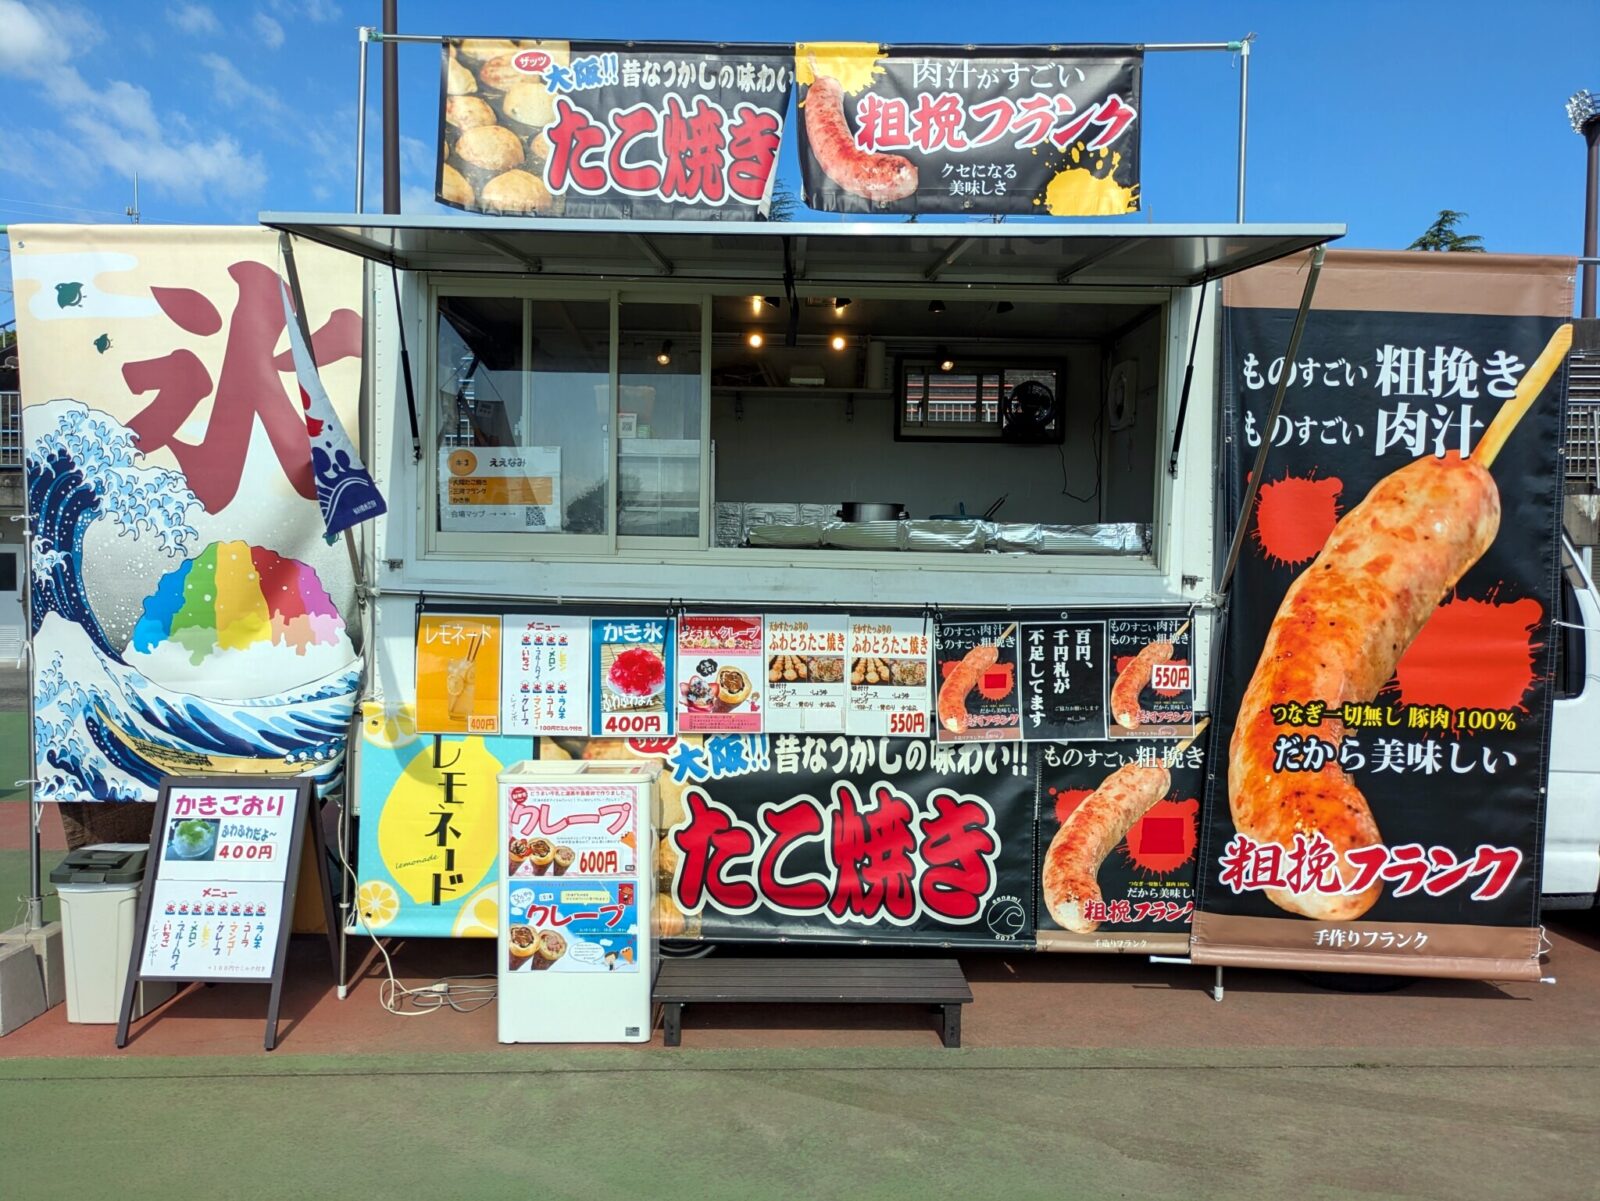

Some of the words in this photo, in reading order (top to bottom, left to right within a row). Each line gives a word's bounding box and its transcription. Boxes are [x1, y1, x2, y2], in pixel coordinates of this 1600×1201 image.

[519, 54, 548, 68] ザッツ
[912, 59, 1086, 90] 肉汁がすごい
[854, 92, 1138, 154] 粗挽フランク
[545, 94, 782, 205] たこ焼き
[941, 163, 1018, 179] クセになる
[949, 180, 1008, 196] 美味しさ
[121, 260, 363, 515] 氷
[489, 458, 526, 468] ええなみ
[425, 623, 492, 646] レモネード
[527, 621, 561, 631] メニュー
[603, 622, 663, 643] かき氷
[769, 633, 845, 652] ふわとろたこ焼き
[852, 635, 928, 655] ふわとろたこ焼き
[1053, 629, 1070, 694] 千円札が
[1028, 629, 1046, 728] 不足してます
[1155, 667, 1190, 688] 550円
[471, 718, 495, 730] 400円
[605, 716, 661, 732] 400円
[890, 712, 925, 733] 550円
[1271, 703, 1401, 728] つなぎ一切無し
[1407, 706, 1450, 729] 豚肉
[1456, 710, 1517, 731] 100%
[1274, 737, 1517, 774] だから美味しい
[175, 795, 284, 816] かきごおり
[425, 734, 468, 906] レモネード
[511, 803, 631, 836] クレープ
[218, 845, 272, 860] 400円
[579, 850, 617, 873] 600円
[670, 782, 999, 923] たこ焼き
[1219, 833, 1523, 901] 粗挽フランク
[202, 888, 238, 898] メニュー
[526, 904, 625, 928] クレープ
[1312, 928, 1428, 949] 手作りフランク
